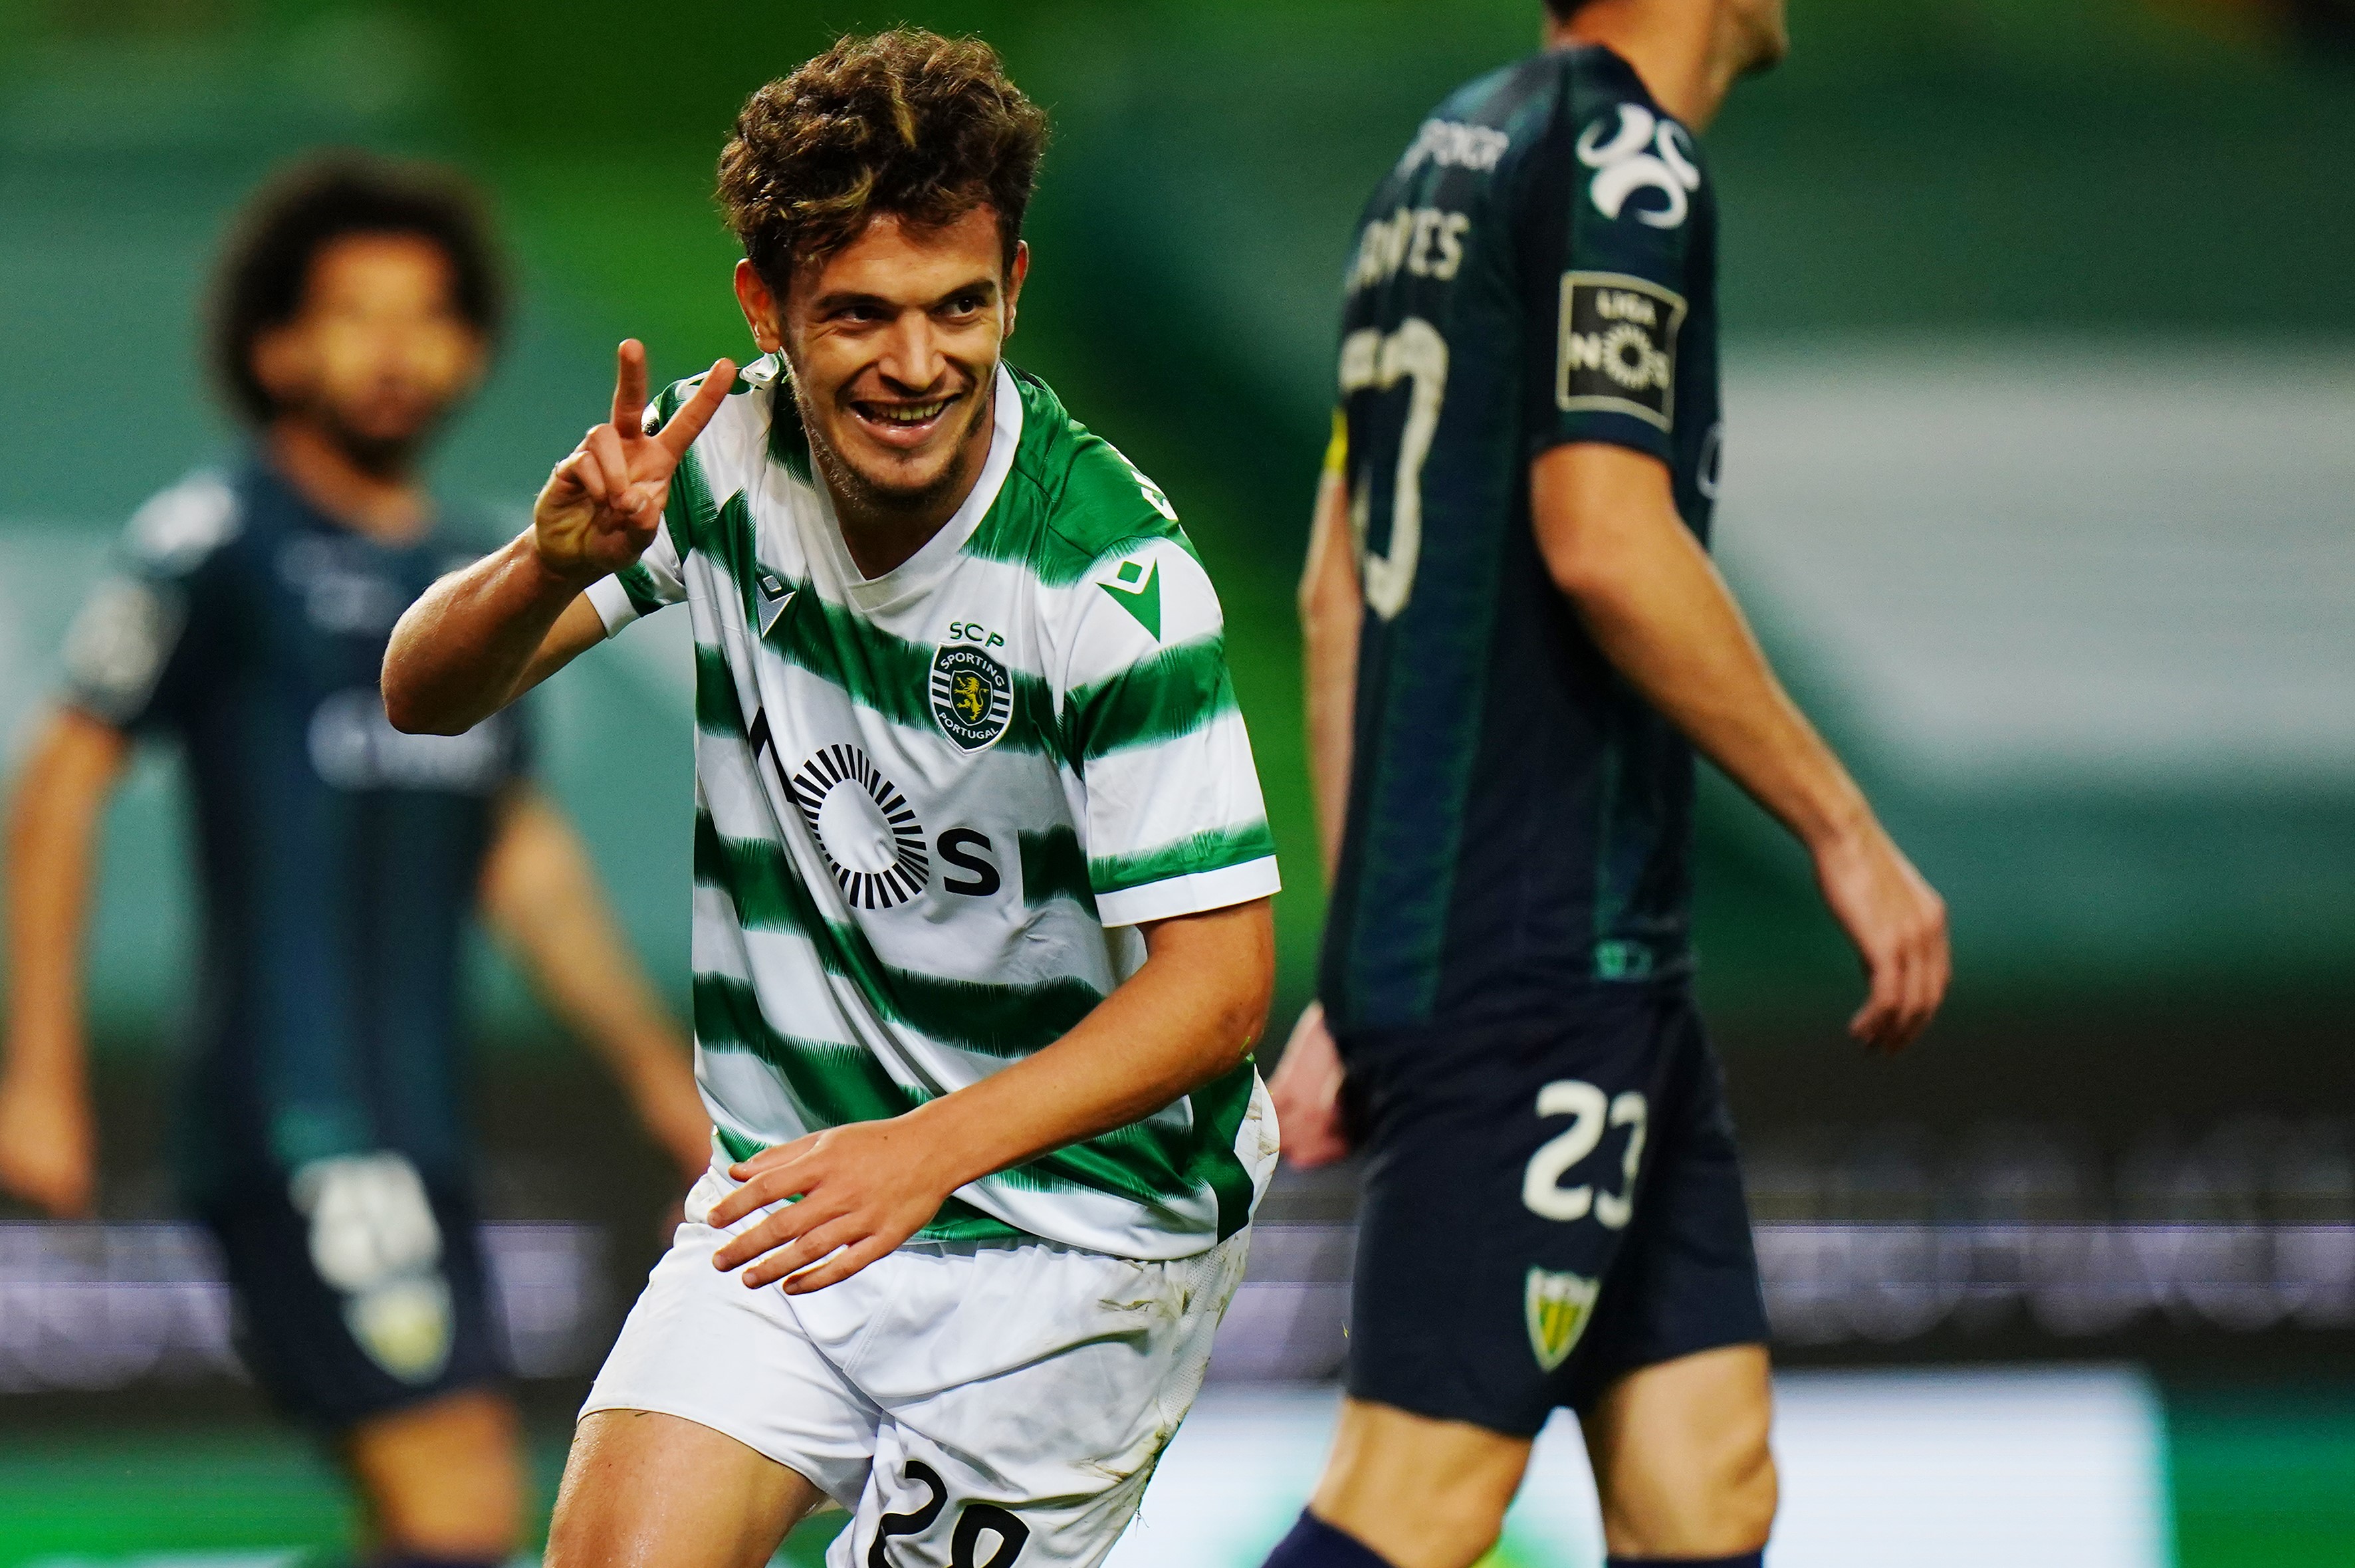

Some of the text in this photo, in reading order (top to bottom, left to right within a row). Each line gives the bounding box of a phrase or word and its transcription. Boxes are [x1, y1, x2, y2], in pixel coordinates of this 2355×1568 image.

[949, 621, 1005, 648] SCP
[940, 652, 1005, 687] SPORTING
[939, 712, 999, 739] PORTUGAL
[1523, 1079, 1647, 1229] 23
